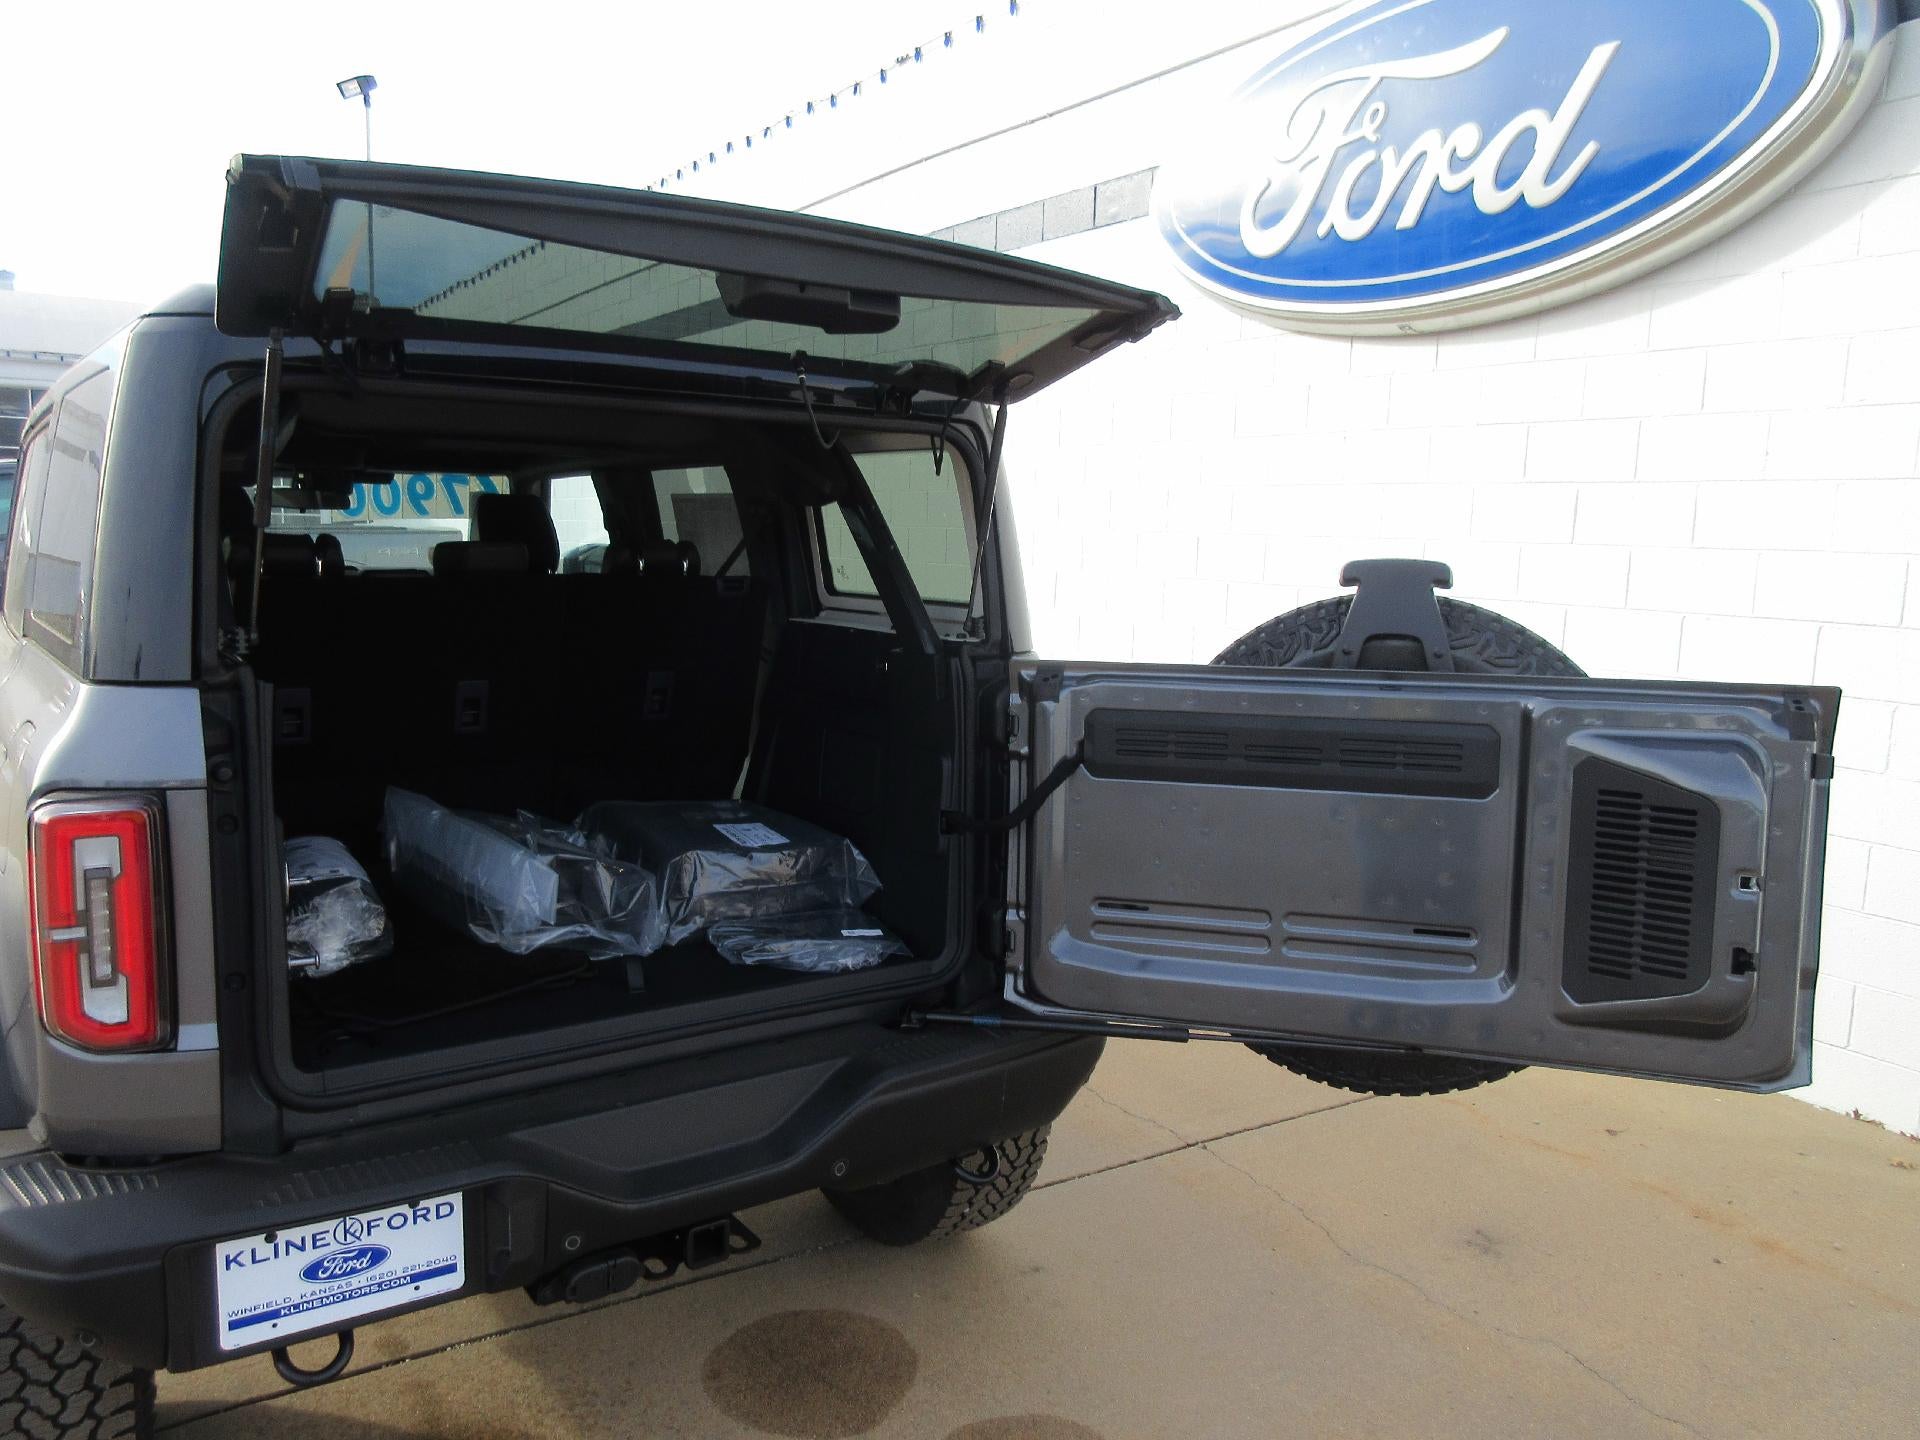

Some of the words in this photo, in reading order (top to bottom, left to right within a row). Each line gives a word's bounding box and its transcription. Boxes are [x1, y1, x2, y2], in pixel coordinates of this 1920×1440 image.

[1239, 25, 1622, 259] Ford
[225, 1230, 330, 1271] KLINE
[366, 1201, 455, 1237] FORD
[318, 1250, 373, 1279] Ford
[228, 1296, 295, 1318] WINFIELD,
[300, 1280, 353, 1300] KANSAS
[366, 1270, 398, 1284] (620)
[402, 1254, 457, 1274] 221-2040
[280, 1276, 412, 1317] KLINEMOTORS.COM
